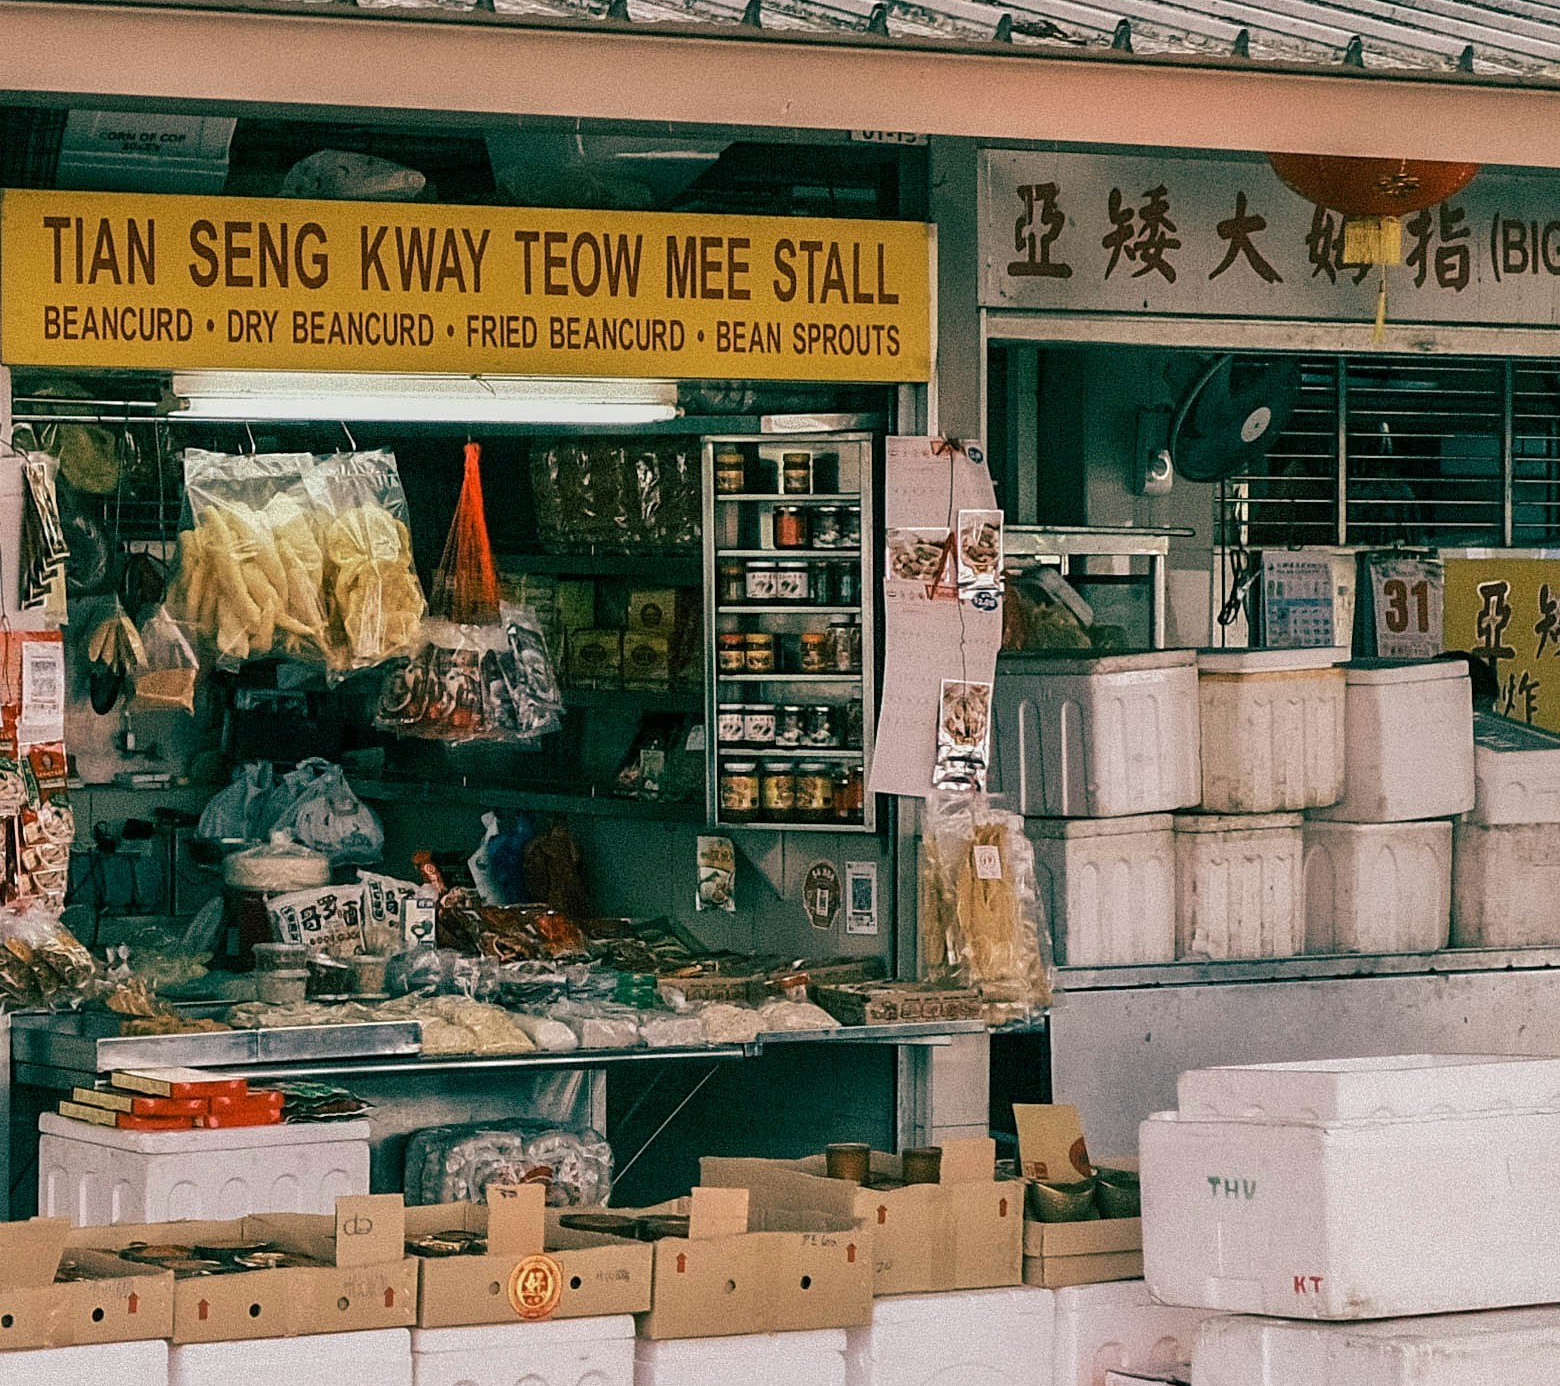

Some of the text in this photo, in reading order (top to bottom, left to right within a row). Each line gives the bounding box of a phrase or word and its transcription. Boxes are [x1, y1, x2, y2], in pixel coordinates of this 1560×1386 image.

[43, 216, 901, 307] TIAN SENG KWAY TEOW MEE STALL
[43, 305, 902, 359] BEANCURD DRY BEANCURD FRIED BEANCURD BEAN SPROUTS
[1383, 578, 1430, 634] 31
[1293, 1275, 1324, 1294] KT
